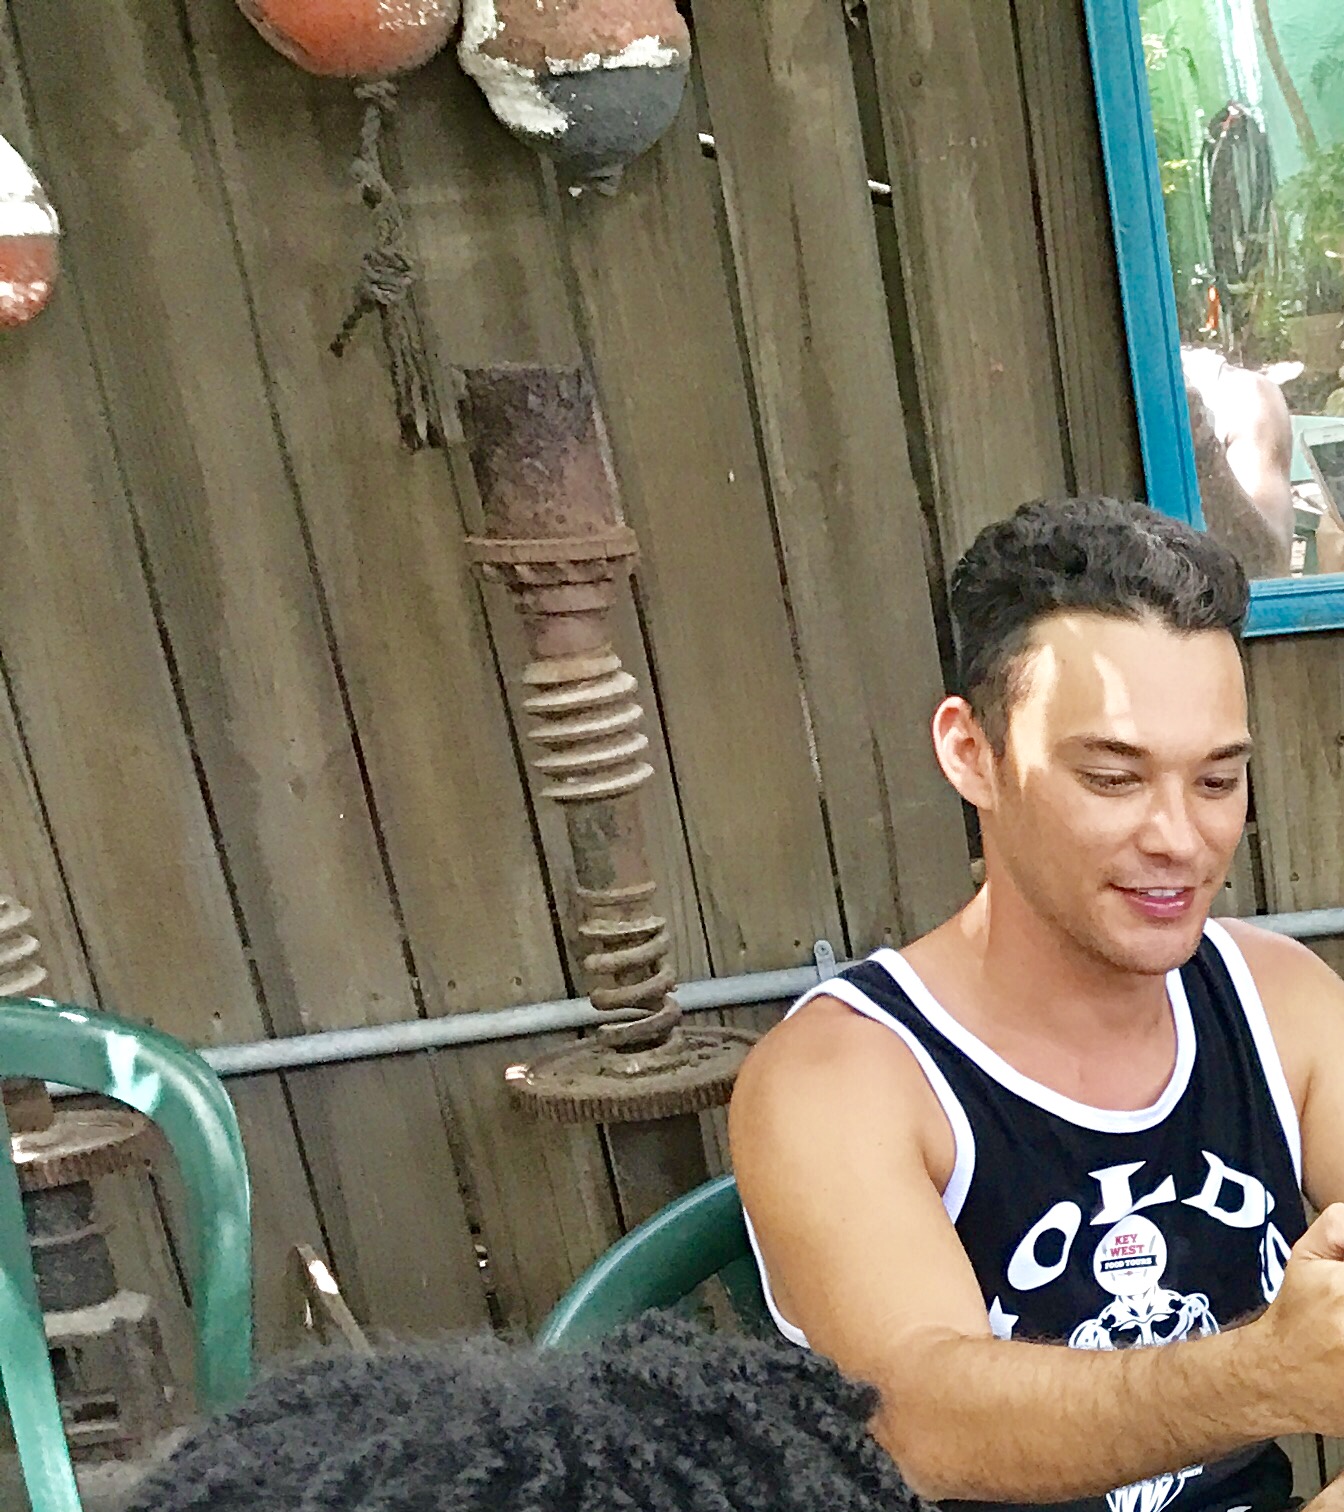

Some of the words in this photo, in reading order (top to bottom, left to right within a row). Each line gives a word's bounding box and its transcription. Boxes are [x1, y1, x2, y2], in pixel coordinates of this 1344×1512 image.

[1115, 1233, 1138, 1246] KEY
[1110, 1244, 1145, 1257] WEST
[1104, 1260, 1125, 1270] FOOD
